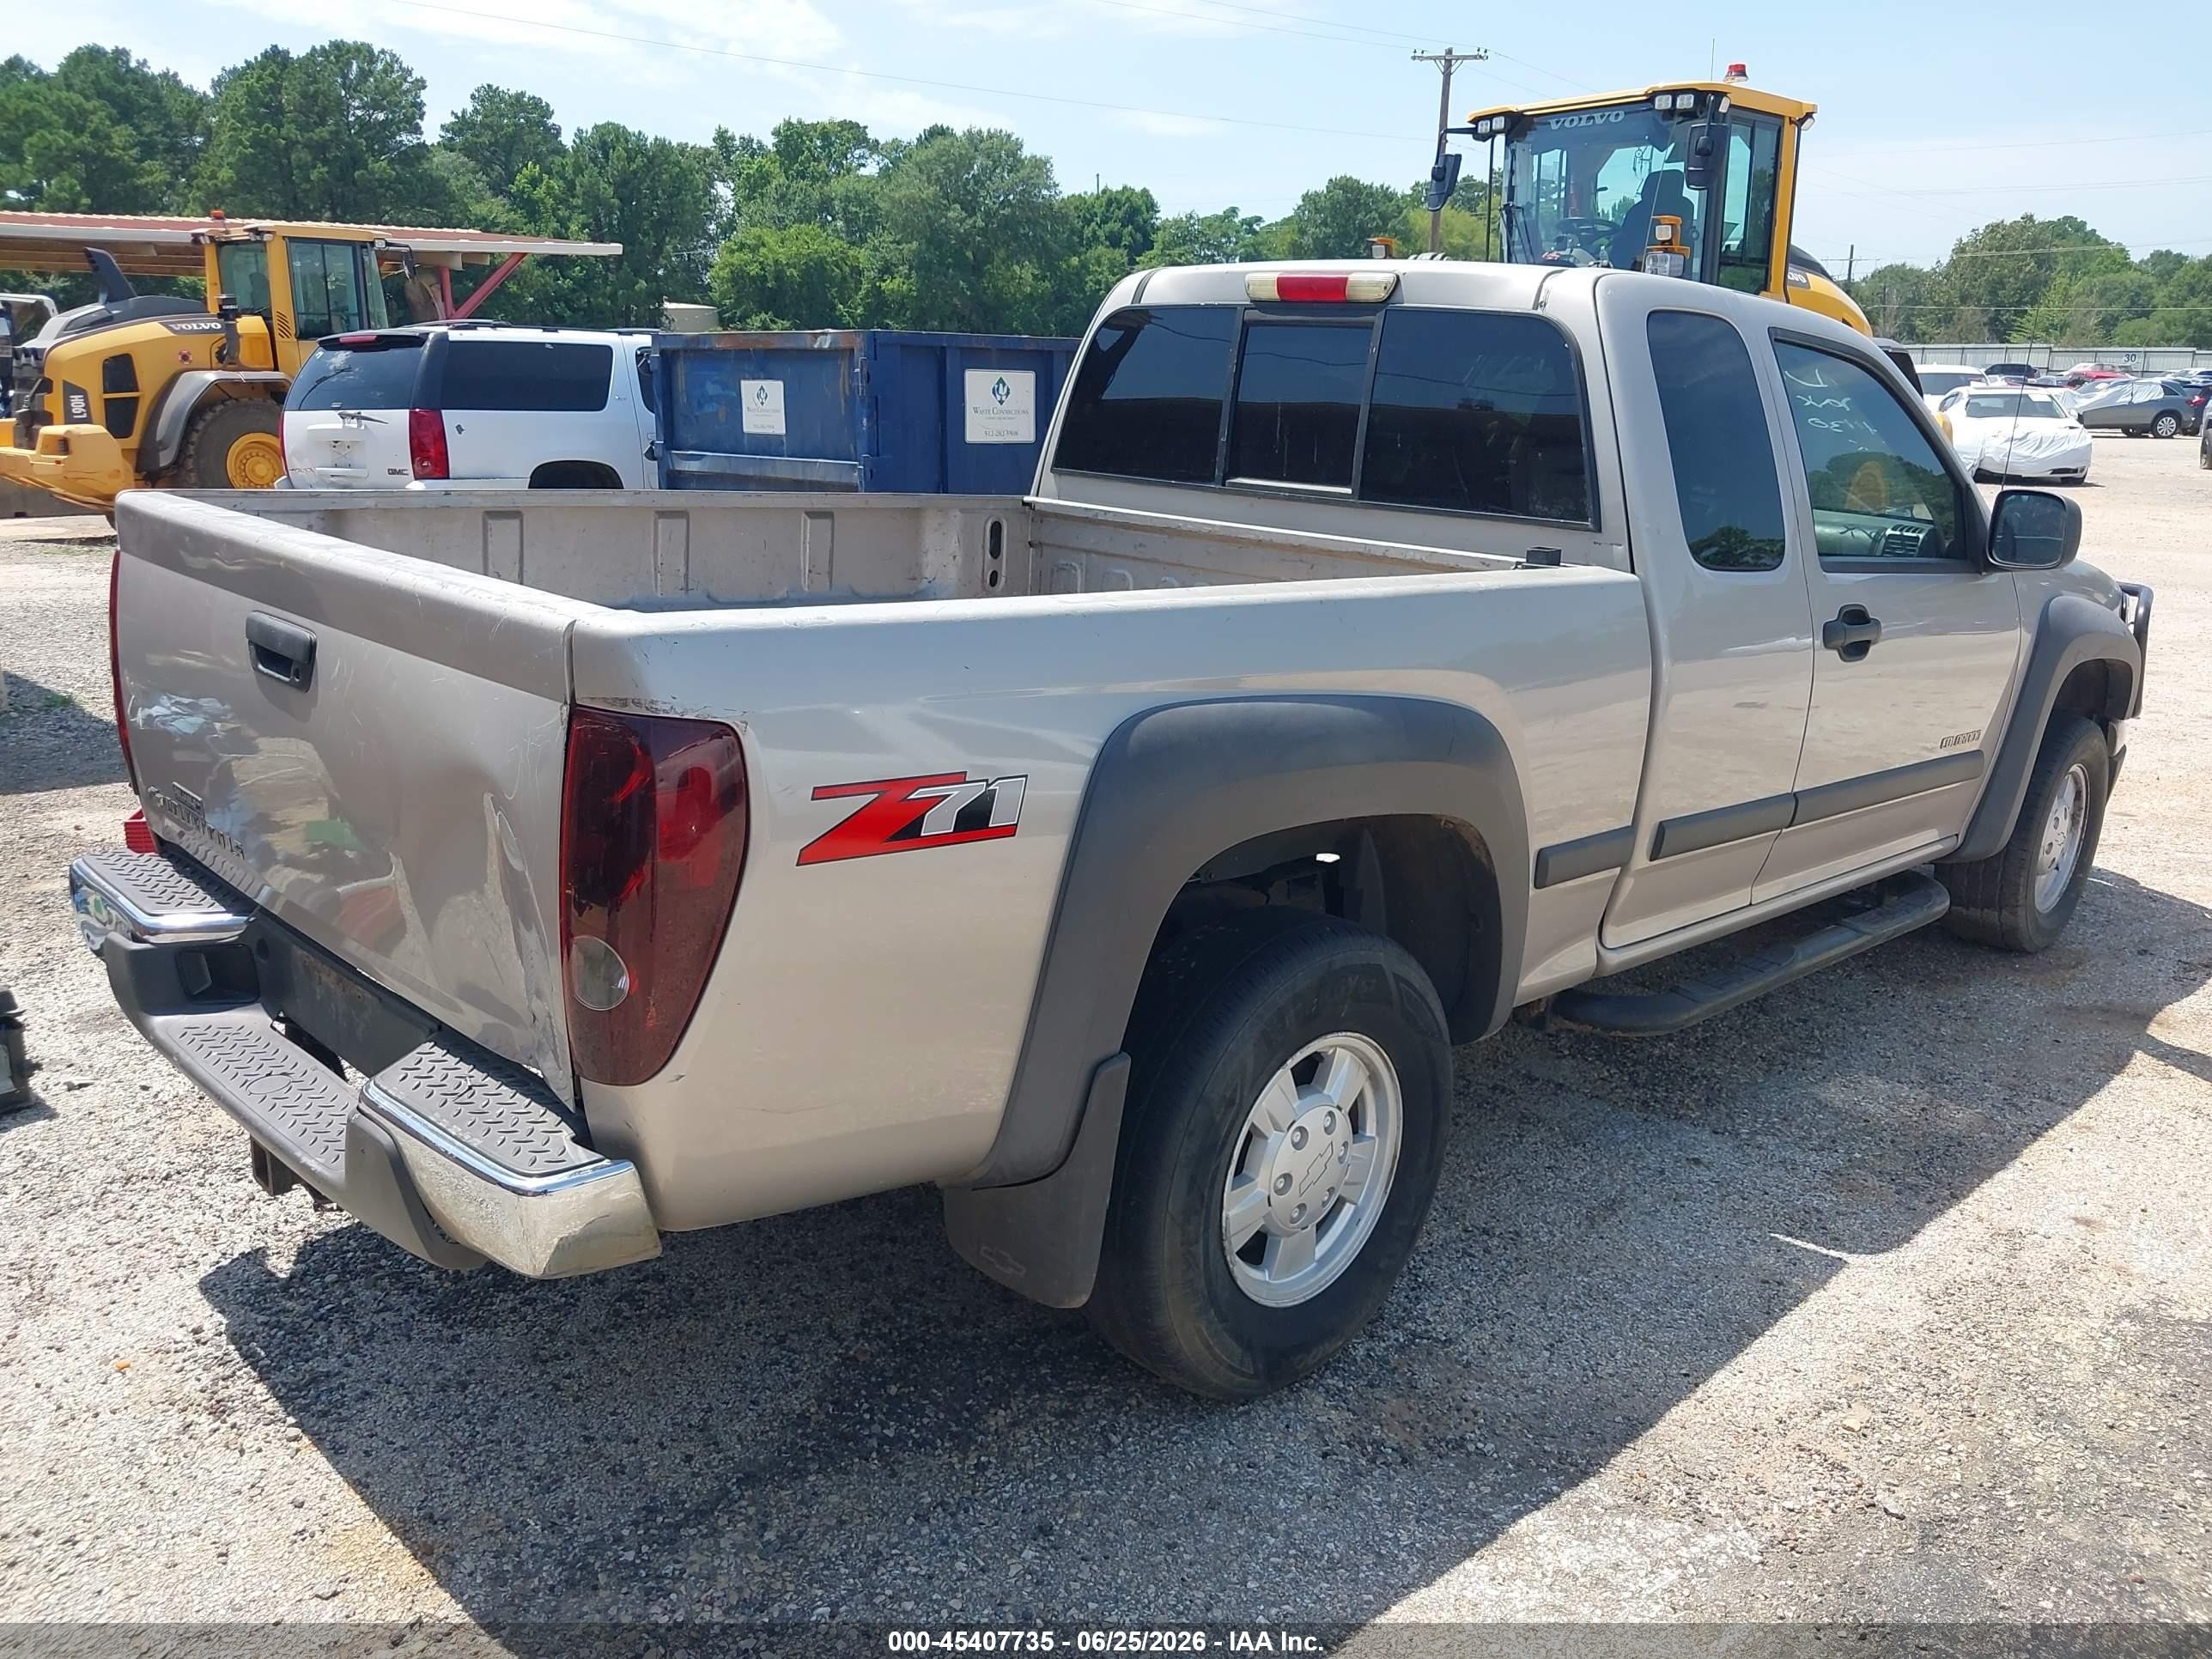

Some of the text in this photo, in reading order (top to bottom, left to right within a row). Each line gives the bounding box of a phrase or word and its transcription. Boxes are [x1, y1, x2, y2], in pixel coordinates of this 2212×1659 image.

[1548, 110, 1625, 130] VOLVO
[170, 321, 222, 331] VOLVO
[2124, 353, 2137, 362] 30
[69, 394, 88, 419] L90H
[796, 771, 1029, 866] Z71
